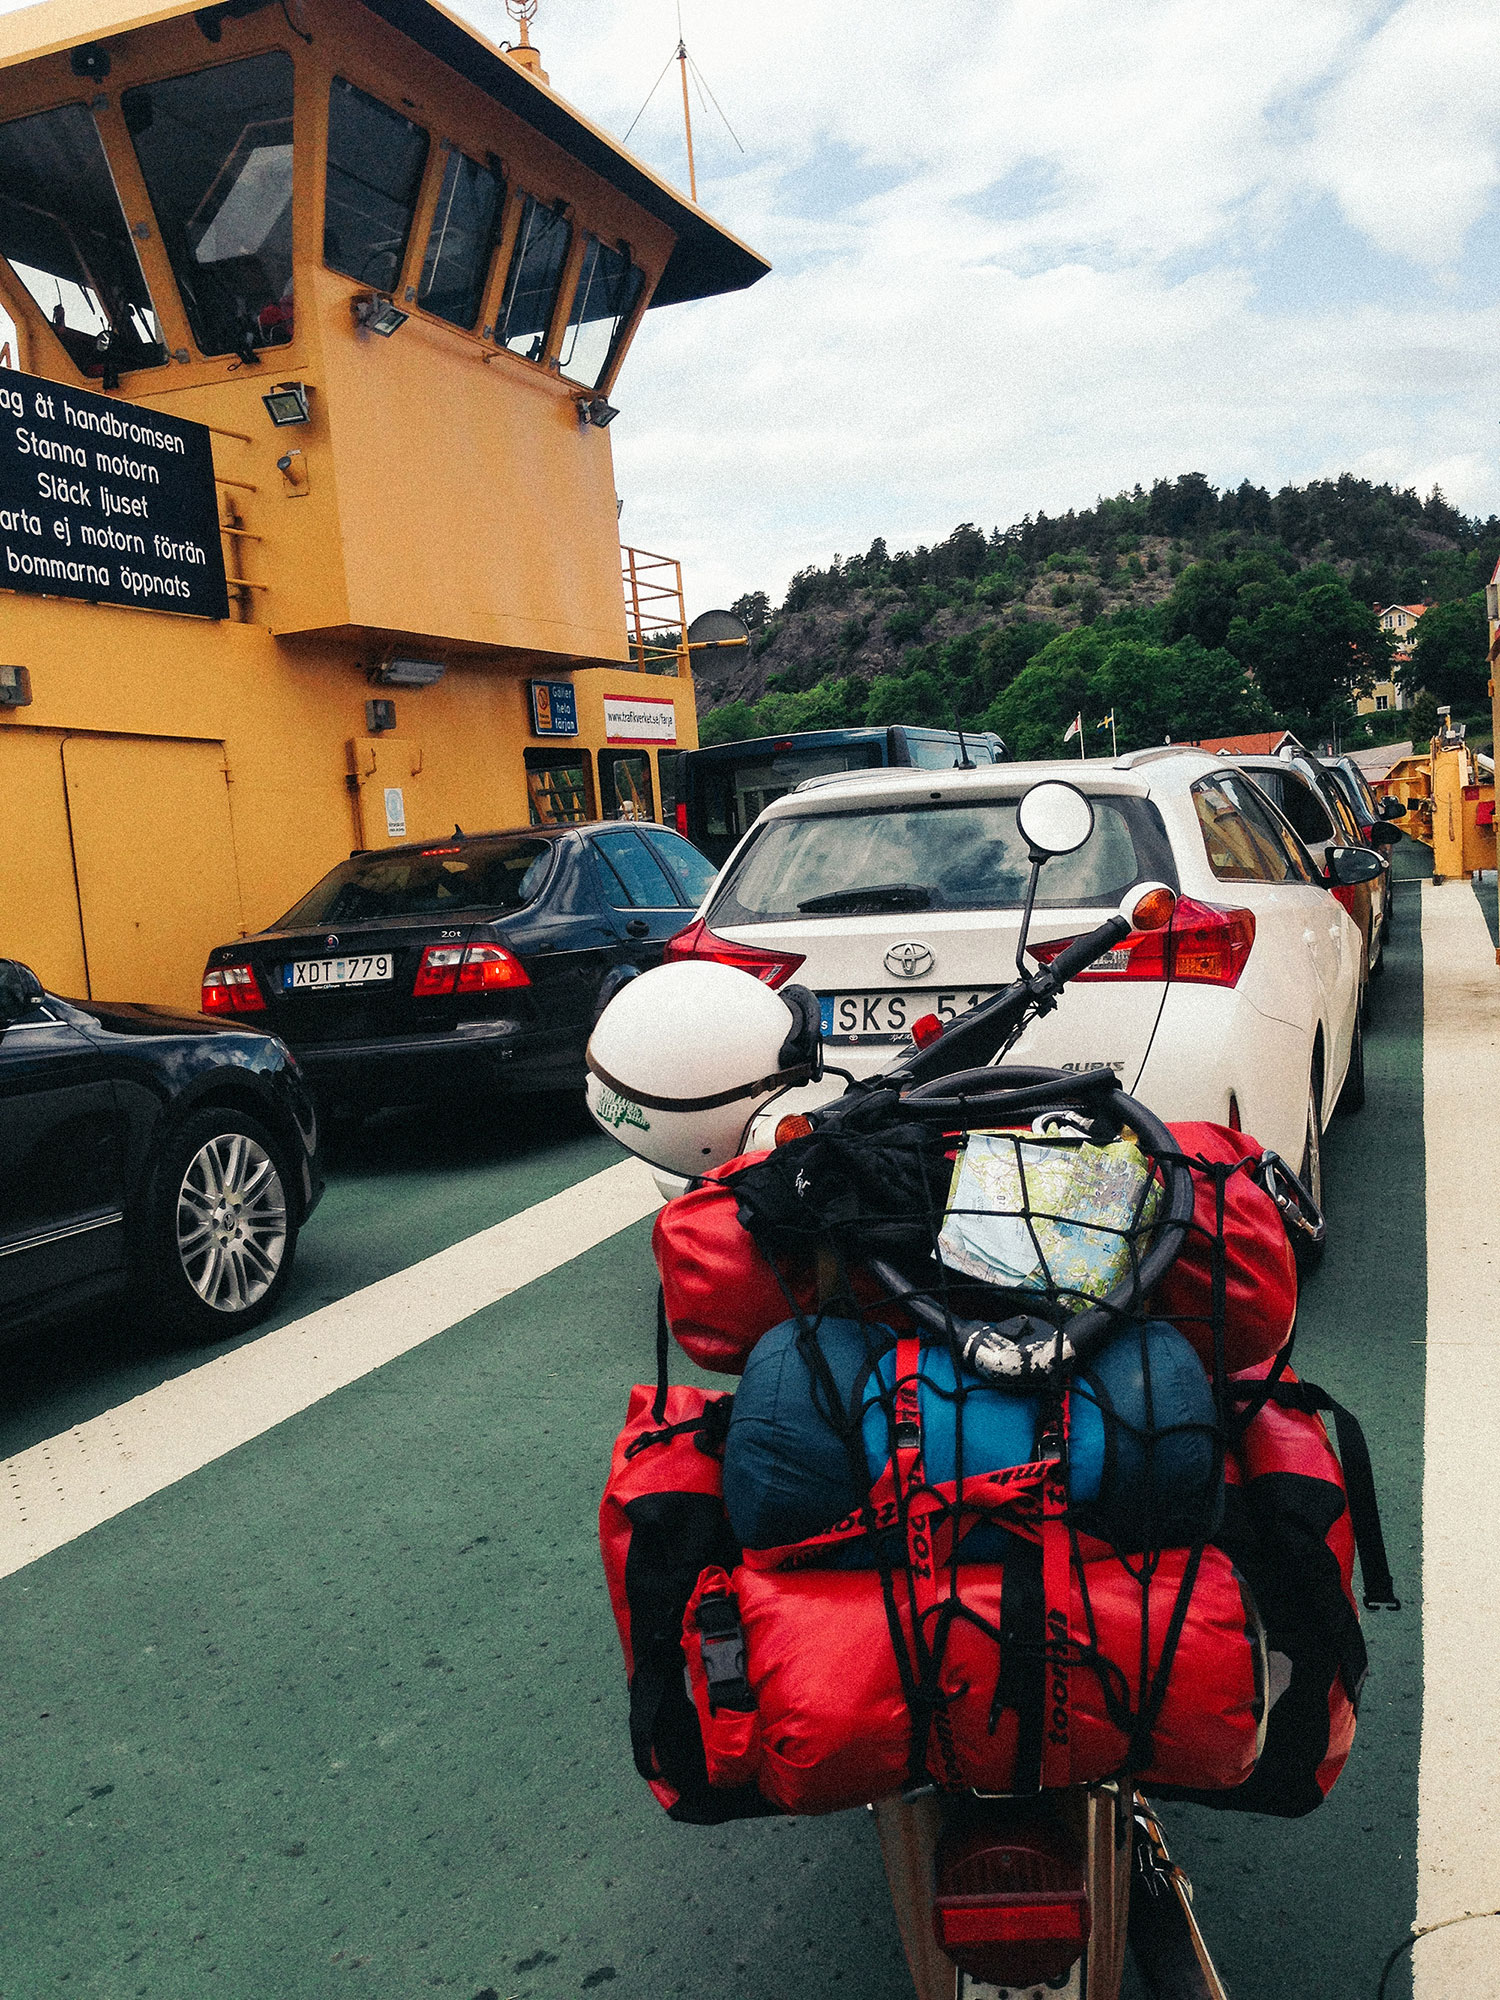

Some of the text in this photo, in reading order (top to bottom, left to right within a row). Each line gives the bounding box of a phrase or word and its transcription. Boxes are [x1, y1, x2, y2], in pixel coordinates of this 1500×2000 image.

[34, 392, 56, 421] åt
[63, 400, 186, 455] handbromsen
[16, 427, 160, 485] Stanna motorn
[37, 471, 149, 519] Släck ljuset
[0, 508, 206, 565] arta ej motorn förrän
[6, 546, 191, 598] bommarna öppnats
[296, 961, 333, 984] XDT
[348, 956, 387, 979] 779
[821, 1020, 828, 1030] S
[838, 997, 906, 1031] SKS
